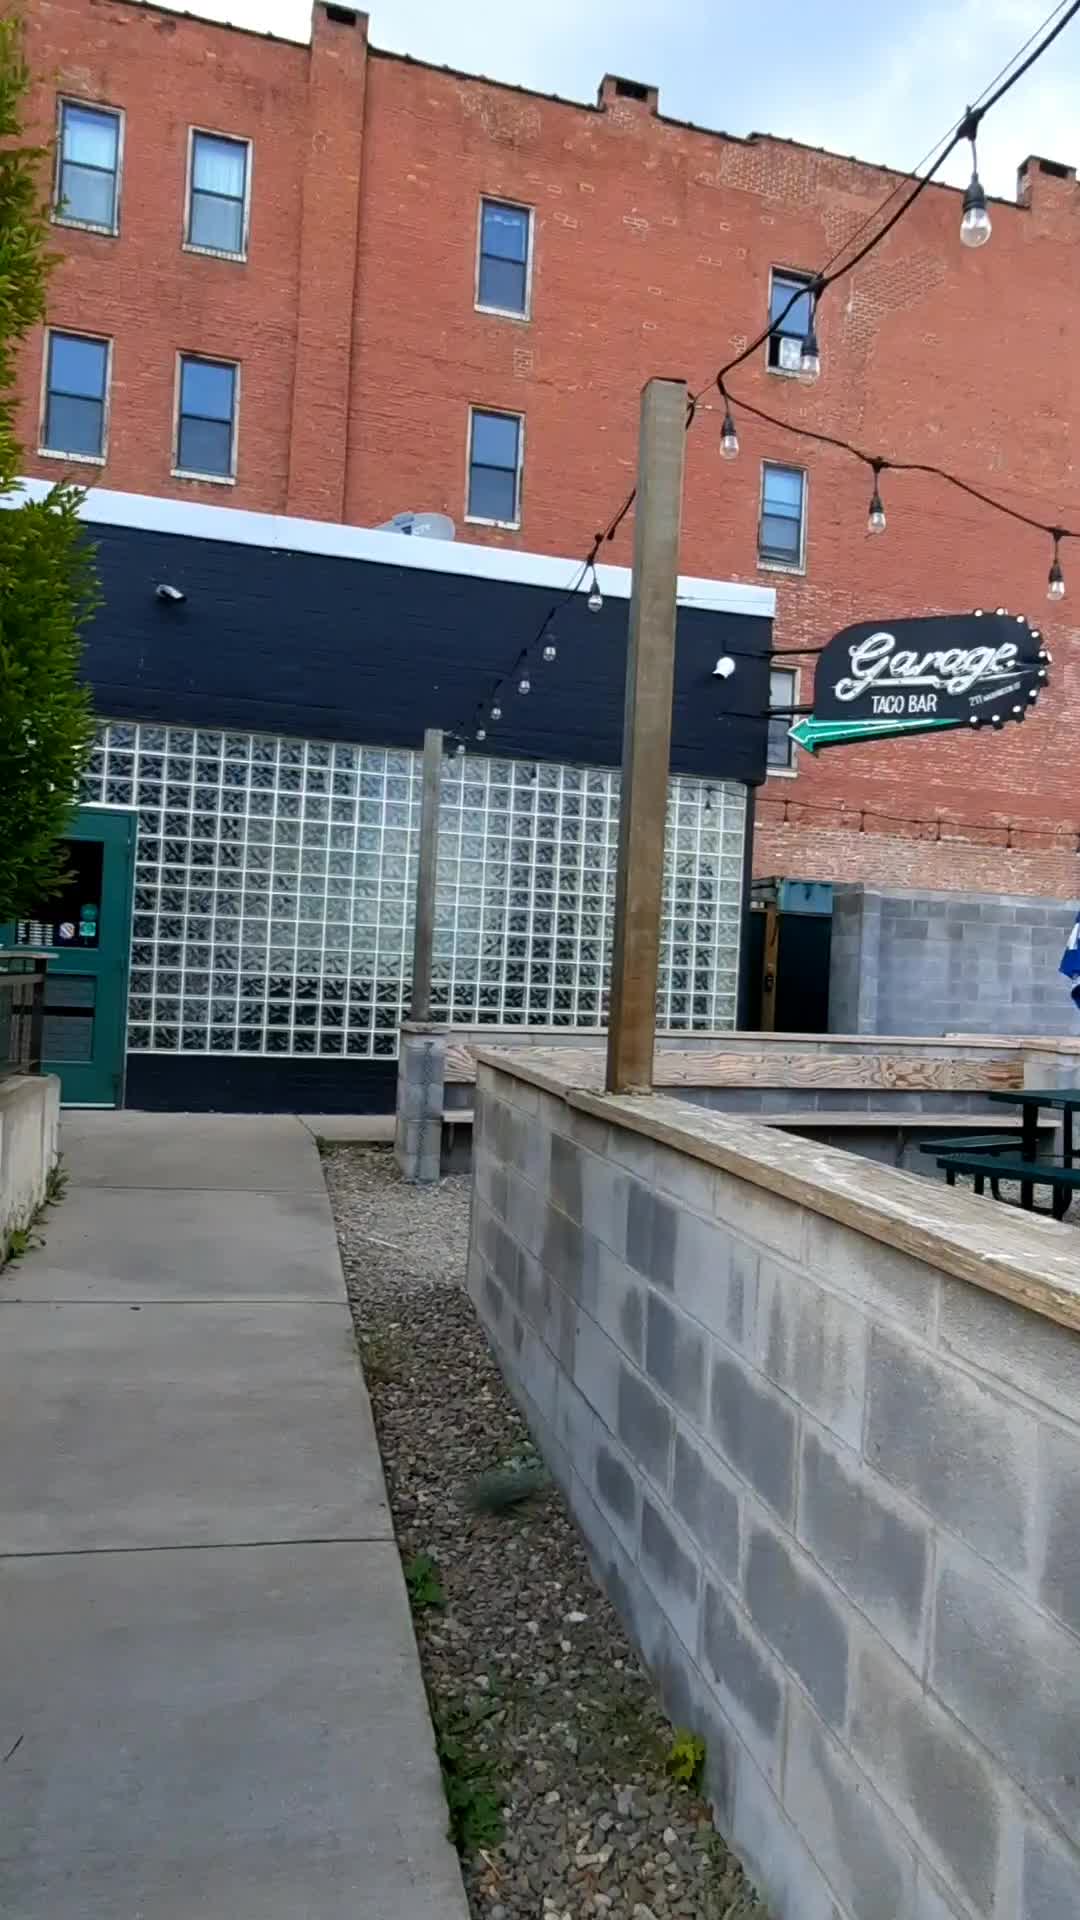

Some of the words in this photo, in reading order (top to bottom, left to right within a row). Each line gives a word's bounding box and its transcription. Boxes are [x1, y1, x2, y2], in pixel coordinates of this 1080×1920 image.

[835, 632, 1018, 699] Garage
[871, 695, 904, 713] TACO
[908, 694, 937, 712] BAR
